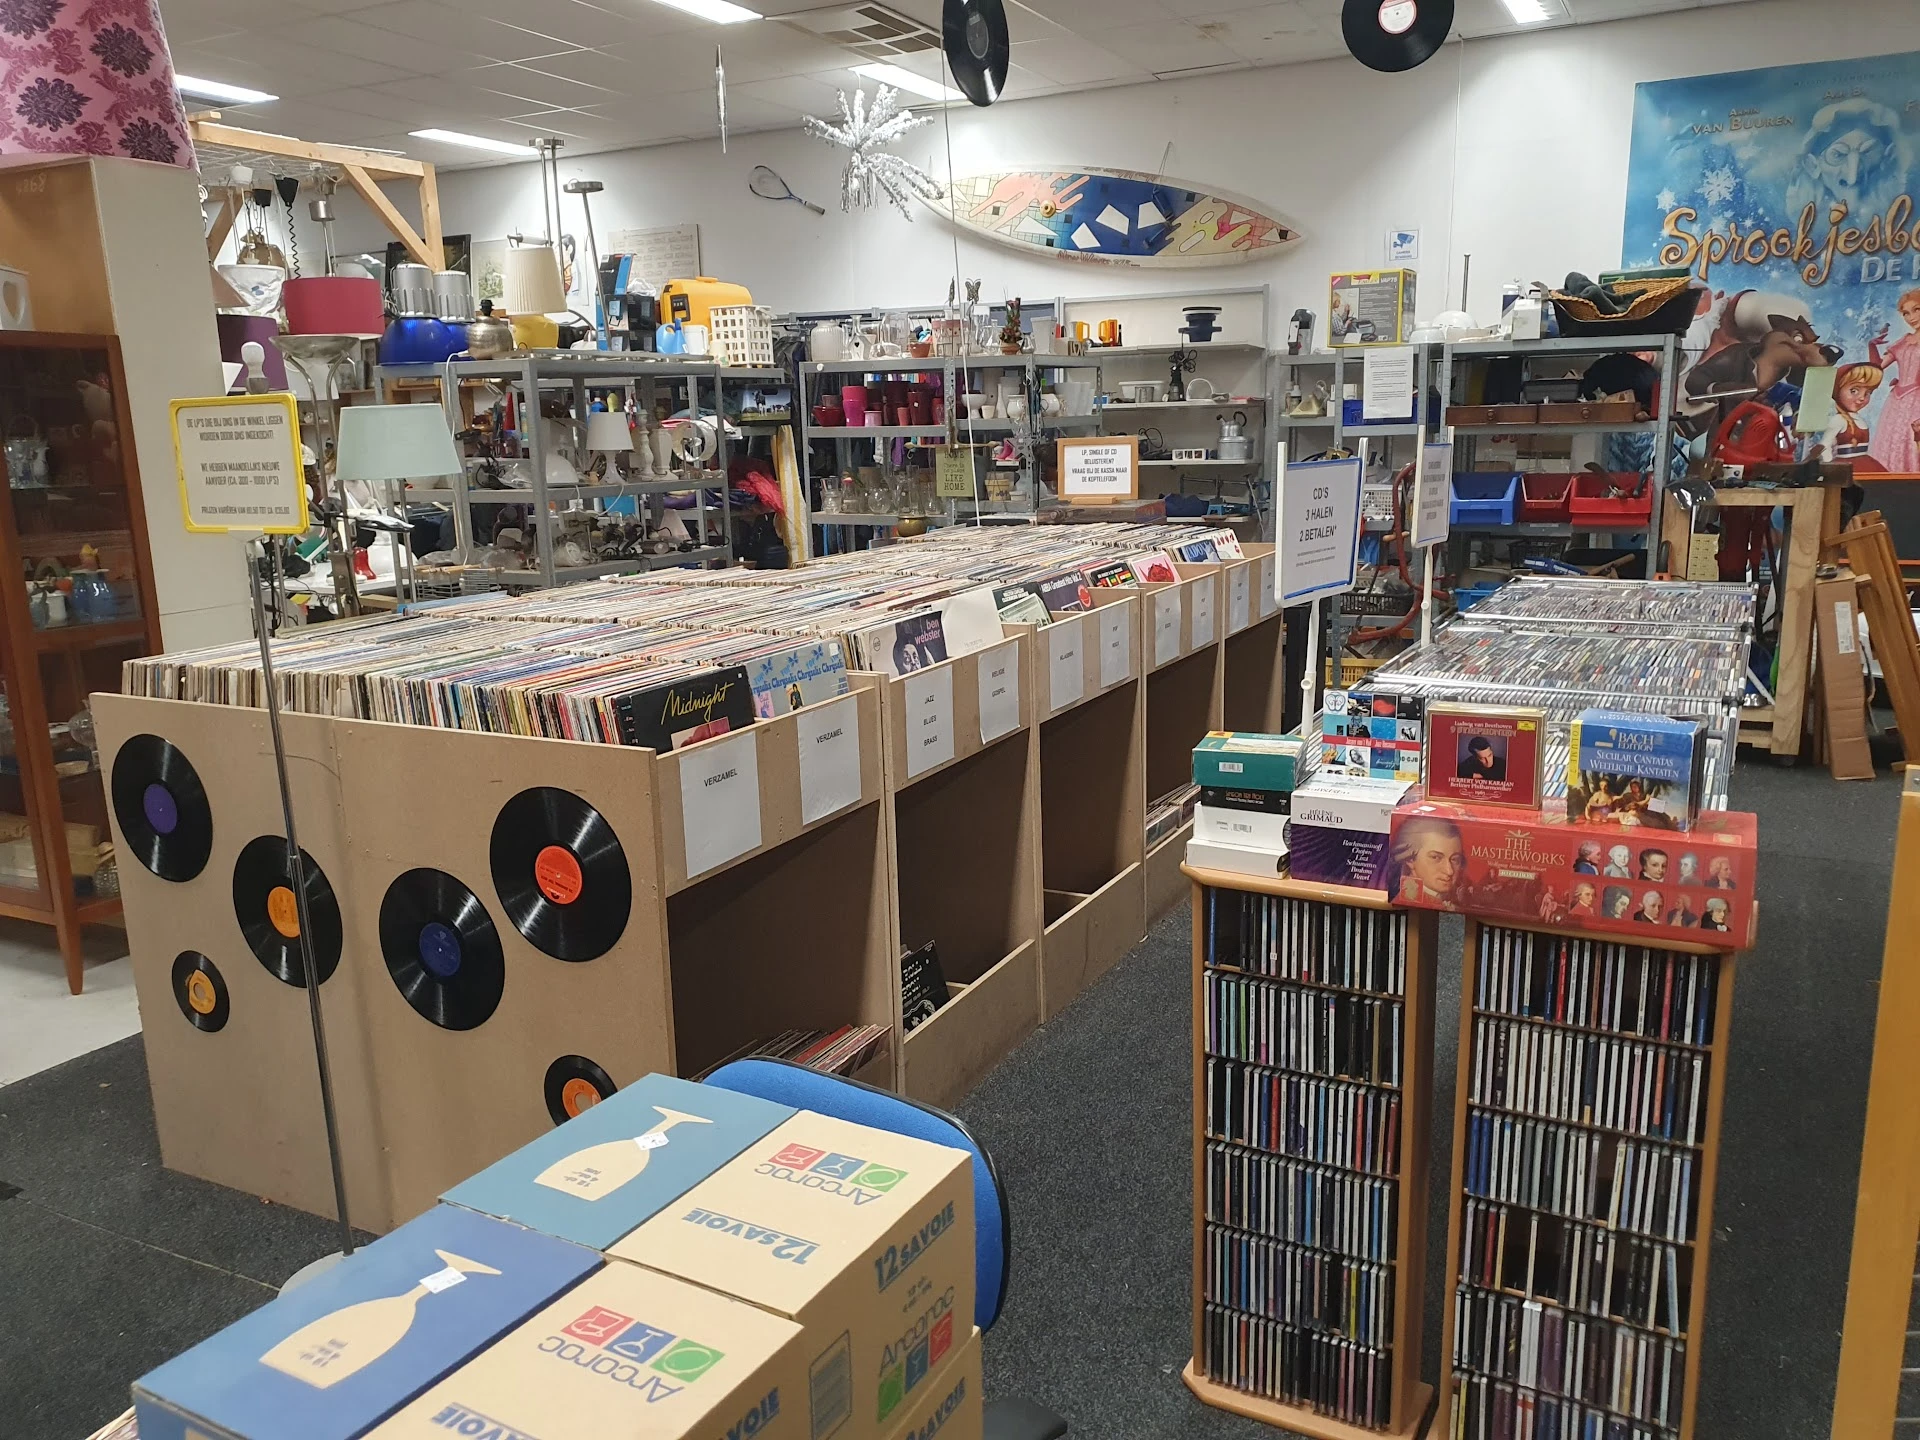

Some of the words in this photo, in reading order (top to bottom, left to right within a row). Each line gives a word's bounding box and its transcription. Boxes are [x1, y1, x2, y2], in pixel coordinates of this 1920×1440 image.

[1691, 123, 1724, 136] VAN
[1729, 114, 1795, 132] BUUREN
[1860, 256, 1902, 283] DE
[246, 416, 266, 426] WINKEL
[266, 415, 284, 425] LIGGEN
[199, 432, 220, 441] WORDEN
[200, 462, 208, 472] WE
[208, 462, 228, 472] HEBBEN
[261, 461, 280, 471] NIEUWE
[944, 474, 964, 482] LIKE
[944, 482, 965, 491] HOME
[1312, 486, 1329, 500] CD'S
[1305, 509, 1310, 521] 3
[1310, 506, 1334, 521] HALEN
[1299, 530, 1304, 542] 2
[926, 618, 940, 631] ben
[914, 628, 941, 645] webster
[797, 667, 822, 681] Chrysalis
[660, 682, 735, 725] Midnight
[924, 694, 935, 705] JAZZ
[923, 715, 937, 726] BLUES
[1454, 720, 1474, 728] Ludwig
[1484, 722, 1513, 730] Beethoven
[815, 728, 843, 744] VERZAMEL
[924, 735, 938, 747] BRASS
[1619, 732, 1655, 746] BACH
[1571, 724, 1579, 765] VOLUME
[1618, 743, 1654, 752] EDITION
[1596, 750, 1632, 762] SECULAR
[1633, 754, 1674, 767] CANTATAS
[1589, 759, 1634, 773] WELTLICHE
[1637, 764, 1680, 778] KANTATEN
[703, 768, 738, 787] VERZAMEL
[1448, 776, 1474, 784] HERBERT
[1488, 779, 1514, 788] KARAJAN
[1471, 783, 1513, 792] Philharmoniker
[1300, 812, 1344, 824] GRIMAUD
[1342, 840, 1383, 852] Rachmaninoff
[1505, 837, 1532, 851] THE
[1352, 848, 1372, 857] Chopin
[1356, 854, 1369, 862] Liszt
[1470, 845, 1565, 866] MASTERWORKS
[1346, 860, 1377, 869] Schumann
[1350, 866, 1372, 874] Brahms
[1487, 860, 1509, 868] Wolfgang
[1353, 873, 1370, 881] Ravel
[754, 1163, 883, 1206] Arcoroc
[682, 1208, 777, 1245] SAVOIE
[900, 1200, 954, 1267] SAVOIE
[879, 1286, 954, 1378] Arcoroc
[537, 1335, 685, 1404] Arcoroc
